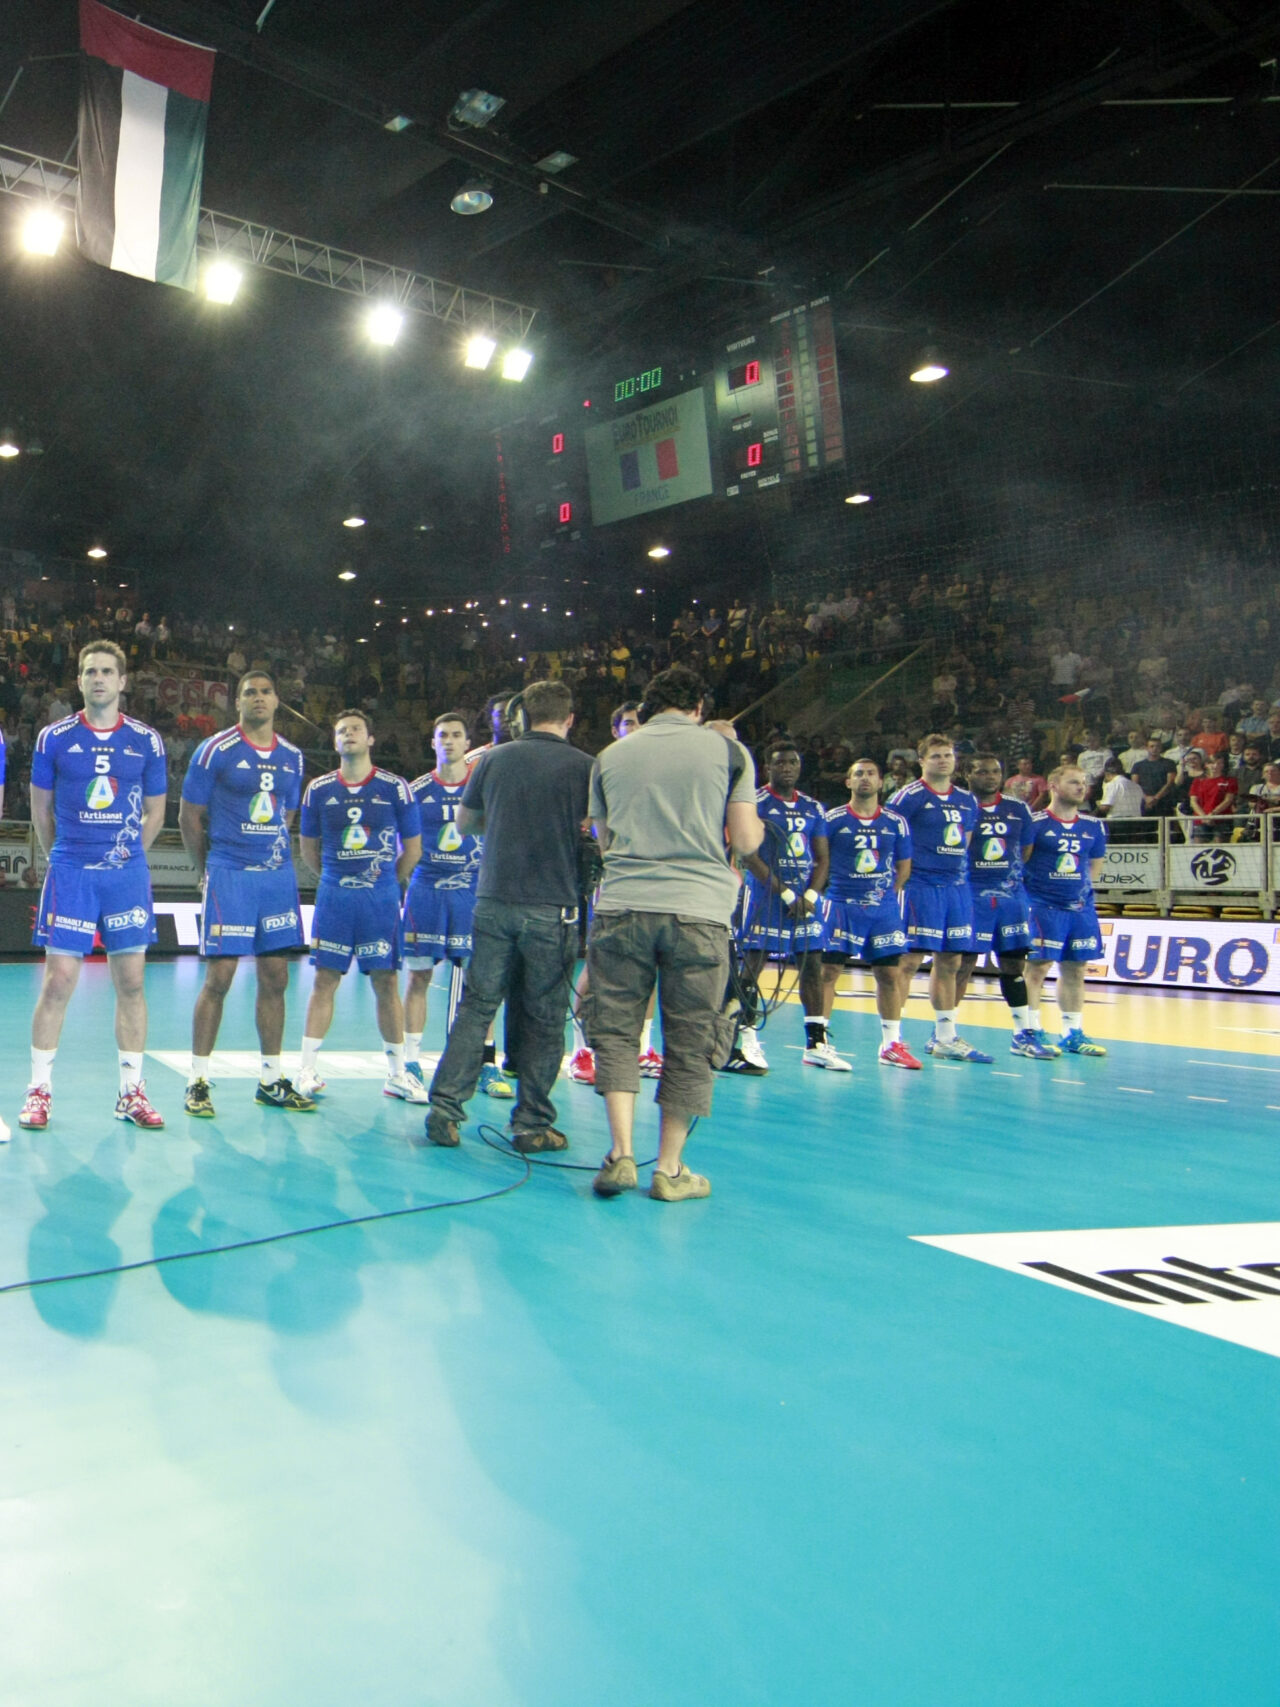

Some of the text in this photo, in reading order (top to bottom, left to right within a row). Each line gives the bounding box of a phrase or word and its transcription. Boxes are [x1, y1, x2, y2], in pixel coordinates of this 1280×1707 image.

[745, 360, 761, 385] 0
[614, 366, 662, 402] 00:00
[552, 433, 564, 454] 0
[747, 443, 762, 467] 0
[559, 502, 571, 523] 0
[94, 755, 111, 774] 5
[259, 772, 275, 792] 8
[347, 807, 363, 824] 9
[942, 810, 962, 823] 18
[786, 817, 807, 832] 19
[980, 822, 1008, 835] 20
[854, 835, 878, 849] 21
[1058, 839, 1081, 853] 25
[1103, 851, 1149, 864] EODIS
[107, 916, 129, 929] FDJ
[266, 917, 287, 930] FDJ
